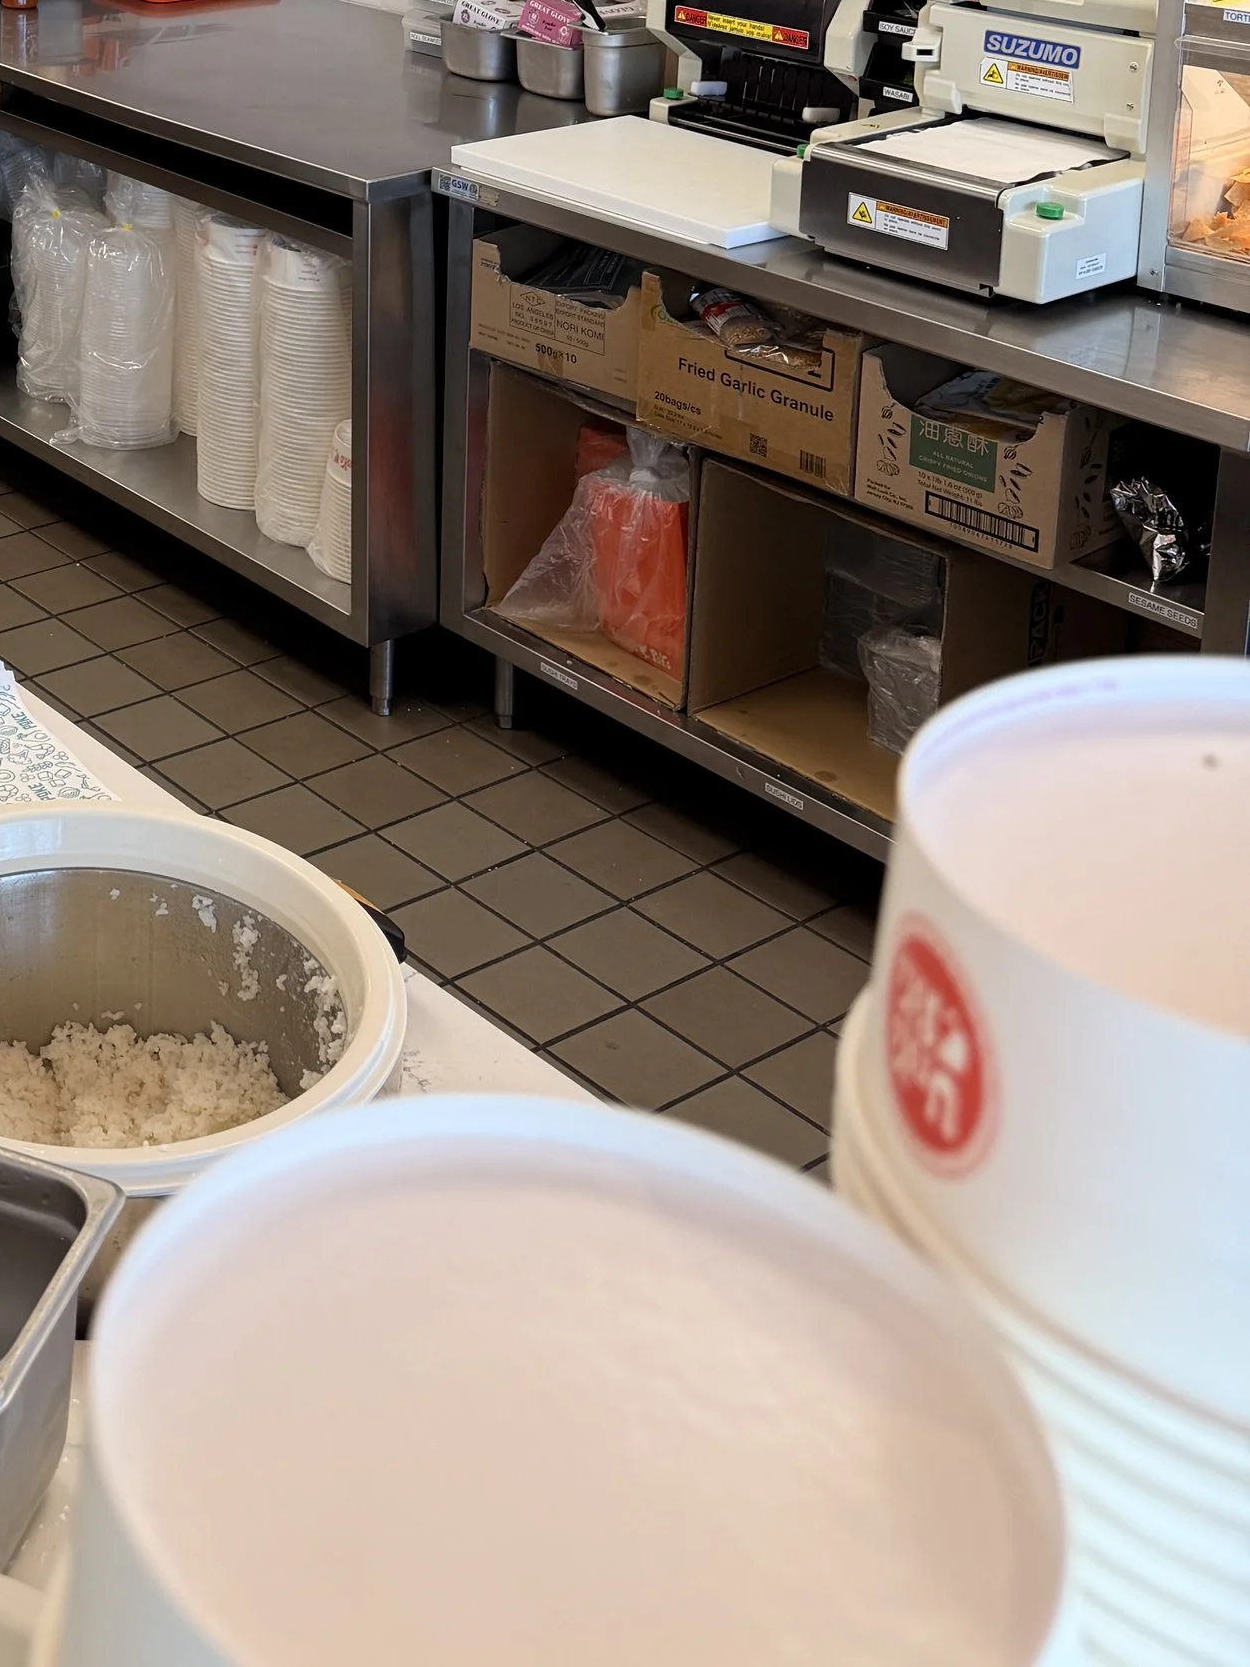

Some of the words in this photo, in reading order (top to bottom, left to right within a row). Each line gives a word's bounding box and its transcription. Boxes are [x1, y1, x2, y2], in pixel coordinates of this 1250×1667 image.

[461, 1, 481, 16] GREAT
[481, 9, 502, 25] GLOVE
[530, 0, 550, 15] GREAT
[551, 8, 572, 24] GLOVE
[987, 34, 1078, 66] SUZUMO
[884, 89, 910, 101] WASABI
[451, 179, 469, 191] GSW
[512, 302, 524, 311] LOS
[526, 306, 554, 321] ANGELES
[556, 319, 579, 334] NORI
[679, 357, 715, 381] Fried
[720, 372, 765, 399] Garlic
[771, 389, 834, 421] Granule
[655, 391, 701, 415] 20bags/cs
[919, 455, 941, 468] CRISPY
[942, 462, 962, 474] FRIED
[964, 469, 988, 482] ONIONS
[933, 451, 944, 459] ALL
[945, 454, 974, 469] NATURAL
[1130, 595, 1165, 615] SESAME
[1167, 609, 1198, 628] SEEDS
